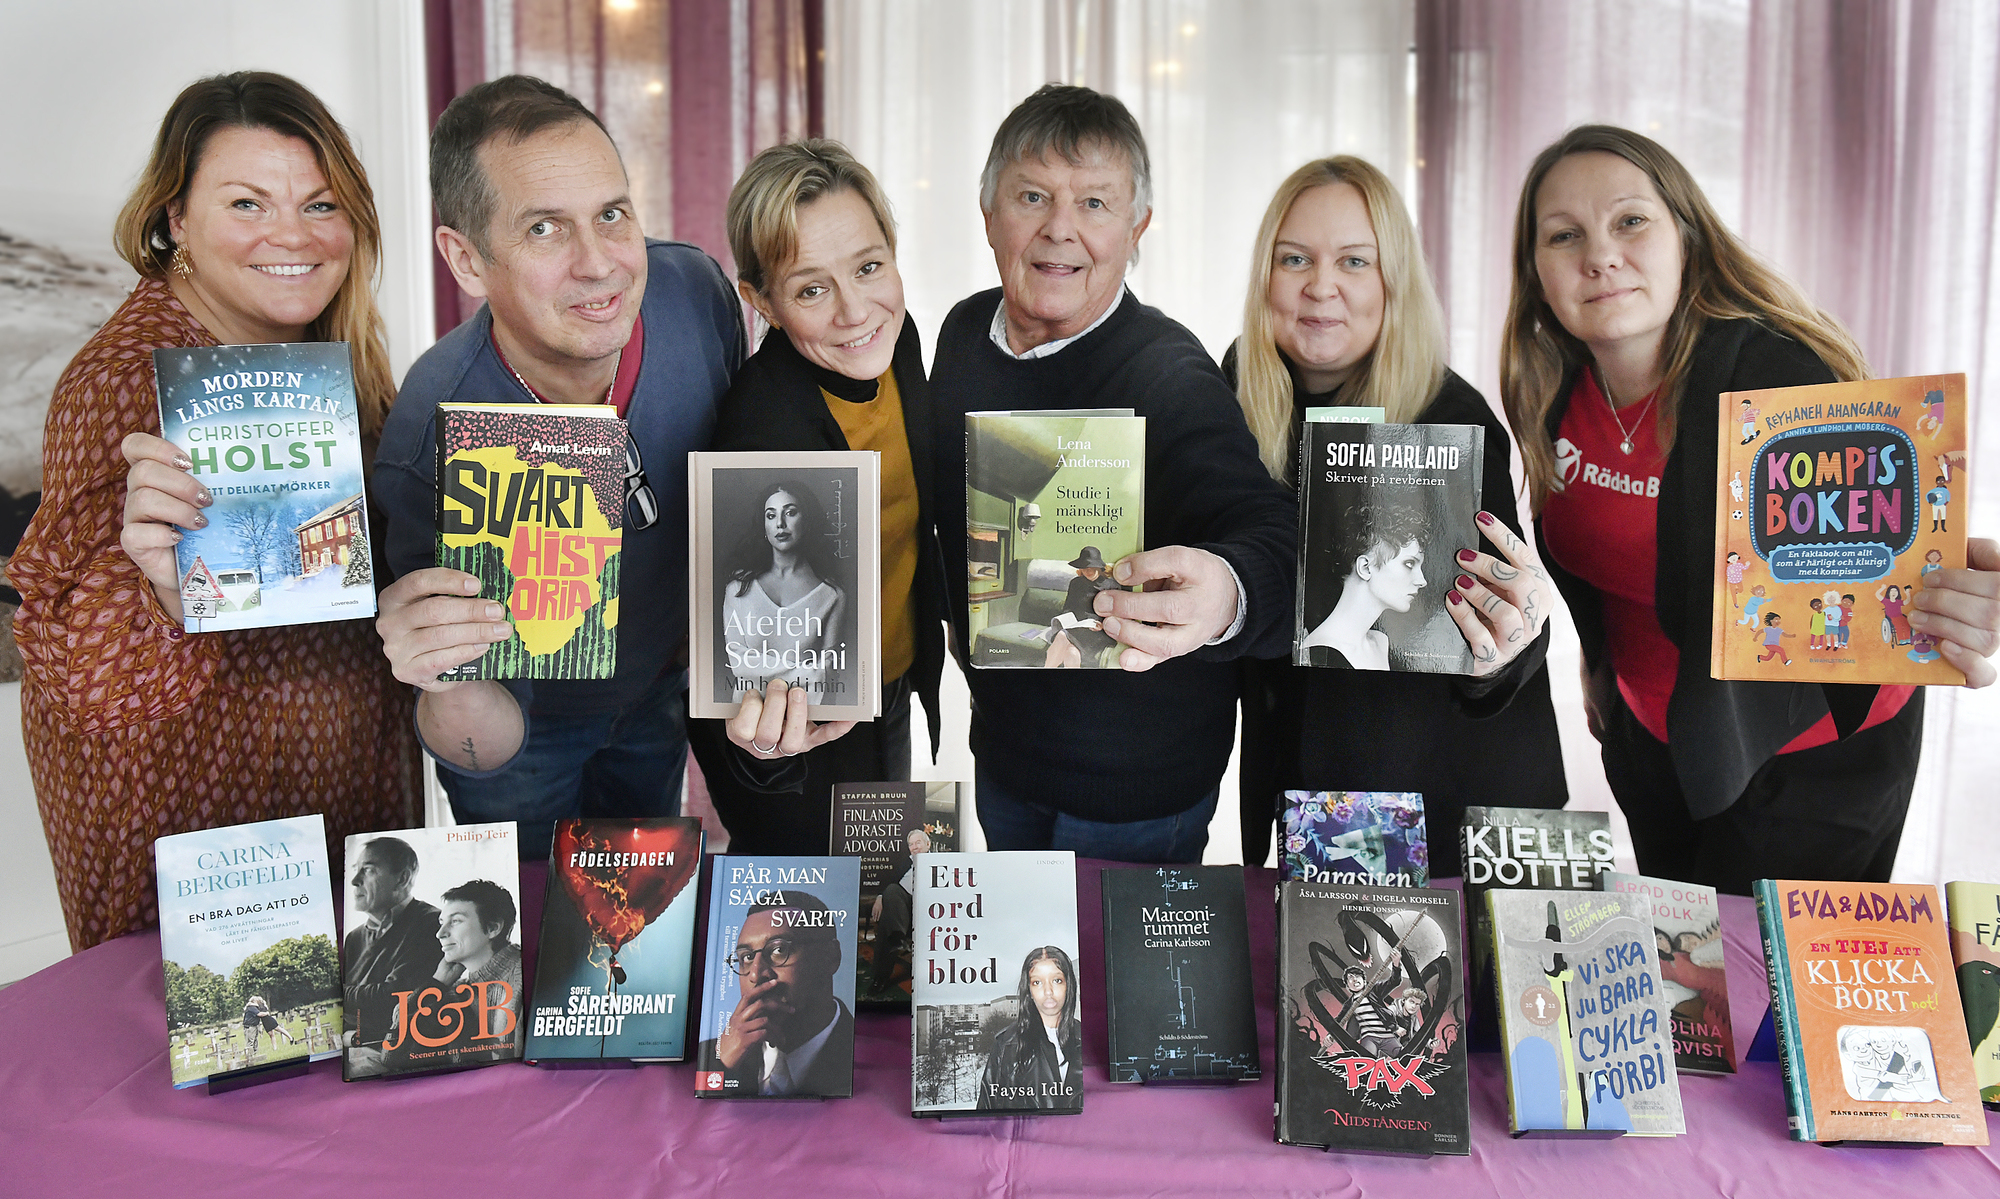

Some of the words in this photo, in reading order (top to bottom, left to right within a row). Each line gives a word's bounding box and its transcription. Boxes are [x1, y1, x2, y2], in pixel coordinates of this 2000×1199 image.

[201, 371, 303, 395] MORDEN
[175, 392, 245, 424] LÄNGS
[253, 391, 341, 415] KARTAN
[1827, 401, 1901, 419] AHANGARAN
[187, 420, 334, 442] CHRISTOFFER
[1784, 425, 1813, 438] ANNIKA
[1814, 423, 1852, 433] LUNDHOLM
[1854, 423, 1886, 432] MOBERG
[531, 441, 570, 454] Amat
[573, 443, 611, 456] Levin
[1057, 436, 1091, 450] Lena
[191, 440, 337, 475] HOLST
[1055, 454, 1131, 468] Andersson
[1326, 442, 1376, 467] SOFIA
[1381, 445, 1459, 470] PARLAND
[226, 484, 276, 495] DELIKAT
[280, 480, 331, 491] MÖRKER
[1325, 472, 1368, 484] Skrivet
[1371, 473, 1385, 487] på
[1389, 475, 1446, 486] revbenen
[1583, 463, 1644, 496] Rädda
[443, 459, 590, 539] SVART
[1057, 486, 1101, 499] Studie
[1106, 486, 1111, 499] i
[1056, 503, 1124, 521] mänskligt
[1765, 488, 1901, 536] BOKEN
[1056, 521, 1118, 534] beteende
[1788, 550, 1799, 558] En
[1800, 549, 1840, 558] faktabok
[1857, 548, 1873, 556] allt
[1795, 558, 1805, 567] är
[1806, 558, 1836, 569] härligt
[1837, 558, 1853, 566] och
[1855, 557, 1887, 568] klurigt
[1798, 568, 1818, 576] med
[1820, 567, 1862, 577] kompisar
[331, 599, 358, 608] Lovereads
[724, 607, 822, 637] Atefeh
[724, 640, 846, 670] Sebdani
[724, 675, 754, 692] Min
[805, 677, 809, 692] i
[814, 679, 845, 693] min
[843, 808, 904, 822] FINLANDS
[1482, 816, 1520, 827] NILLA
[446, 831, 483, 842] Philip
[484, 830, 509, 839] Teir
[844, 824, 902, 837] DYRASTE
[842, 839, 903, 853] ADVOKAT
[1466, 825, 1616, 866] KJELLS
[197, 841, 292, 871] CARINA
[570, 851, 675, 868] FÖDELSEDAGEN
[177, 860, 315, 897] BERGFELDT
[730, 863, 772, 884] FÅR
[776, 868, 827, 884] MAN
[929, 865, 978, 888] Ett
[1303, 864, 1413, 888] Parasiten
[728, 886, 786, 905] SÄGA
[1299, 889, 1315, 899] ÅSA
[1318, 891, 1359, 900] LARSSON
[1362, 893, 1370, 901] &
[1372, 893, 1407, 903] INGELA
[1409, 895, 1449, 905] KORSELL
[1615, 880, 1664, 899] BRÖD
[1672, 889, 1709, 906] OCH
[189, 912, 205, 924] EN
[209, 908, 233, 921] BRA
[237, 904, 262, 917] DAG
[266, 899, 287, 911] ATT
[290, 894, 309, 908] DÖ
[928, 893, 984, 919] ord
[1141, 905, 1216, 923] Marconi-
[1342, 904, 1371, 912] HENRIK
[1373, 905, 1406, 914] JONSSON
[1564, 901, 1592, 922] ELLEN
[1652, 903, 1693, 921] JÖLK
[230, 917, 274, 928] AVRÄTTNINGAR
[770, 910, 847, 927] SVART?
[1568, 902, 1621, 937] STRÖMBERG
[928, 926, 978, 952] för
[1143, 923, 1210, 936] rummet
[1144, 938, 1173, 948] Carina
[1174, 938, 1211, 947] Karlsson
[1764, 938, 1773, 955] EN
[1810, 943, 1831, 953] EN
[1836, 940, 1889, 955] TJEJ
[1893, 946, 1922, 957] ATT
[1605, 942, 1646, 973] SKA
[927, 958, 998, 985] blod
[1767, 958, 1777, 987] TJEJ
[1804, 959, 1934, 986] KLICKA
[570, 986, 591, 995] SOFIE
[719, 975, 727, 1001] trygghet
[1600, 972, 1654, 1015] BARA
[567, 994, 676, 1015] SARENBRANT
[1771, 988, 1781, 1013] ATT
[1833, 984, 1910, 1013] BORT
[1911, 992, 1940, 1013] not!
[382, 980, 517, 1051] J&B
[536, 1006, 563, 1016] CARINA
[533, 1015, 625, 1036] BERGFELDT
[409, 1050, 436, 1060] Scener
[437, 1050, 446, 1058] ur
[448, 1047, 459, 1056] ett
[460, 1042, 515, 1054] skenäktenskap
[1338, 1054, 1437, 1095] PAX
[989, 1083, 1035, 1100] Faysa
[1041, 1081, 1073, 1096] Idle
[1325, 1108, 1432, 1131] NIDSTÅNGEN
